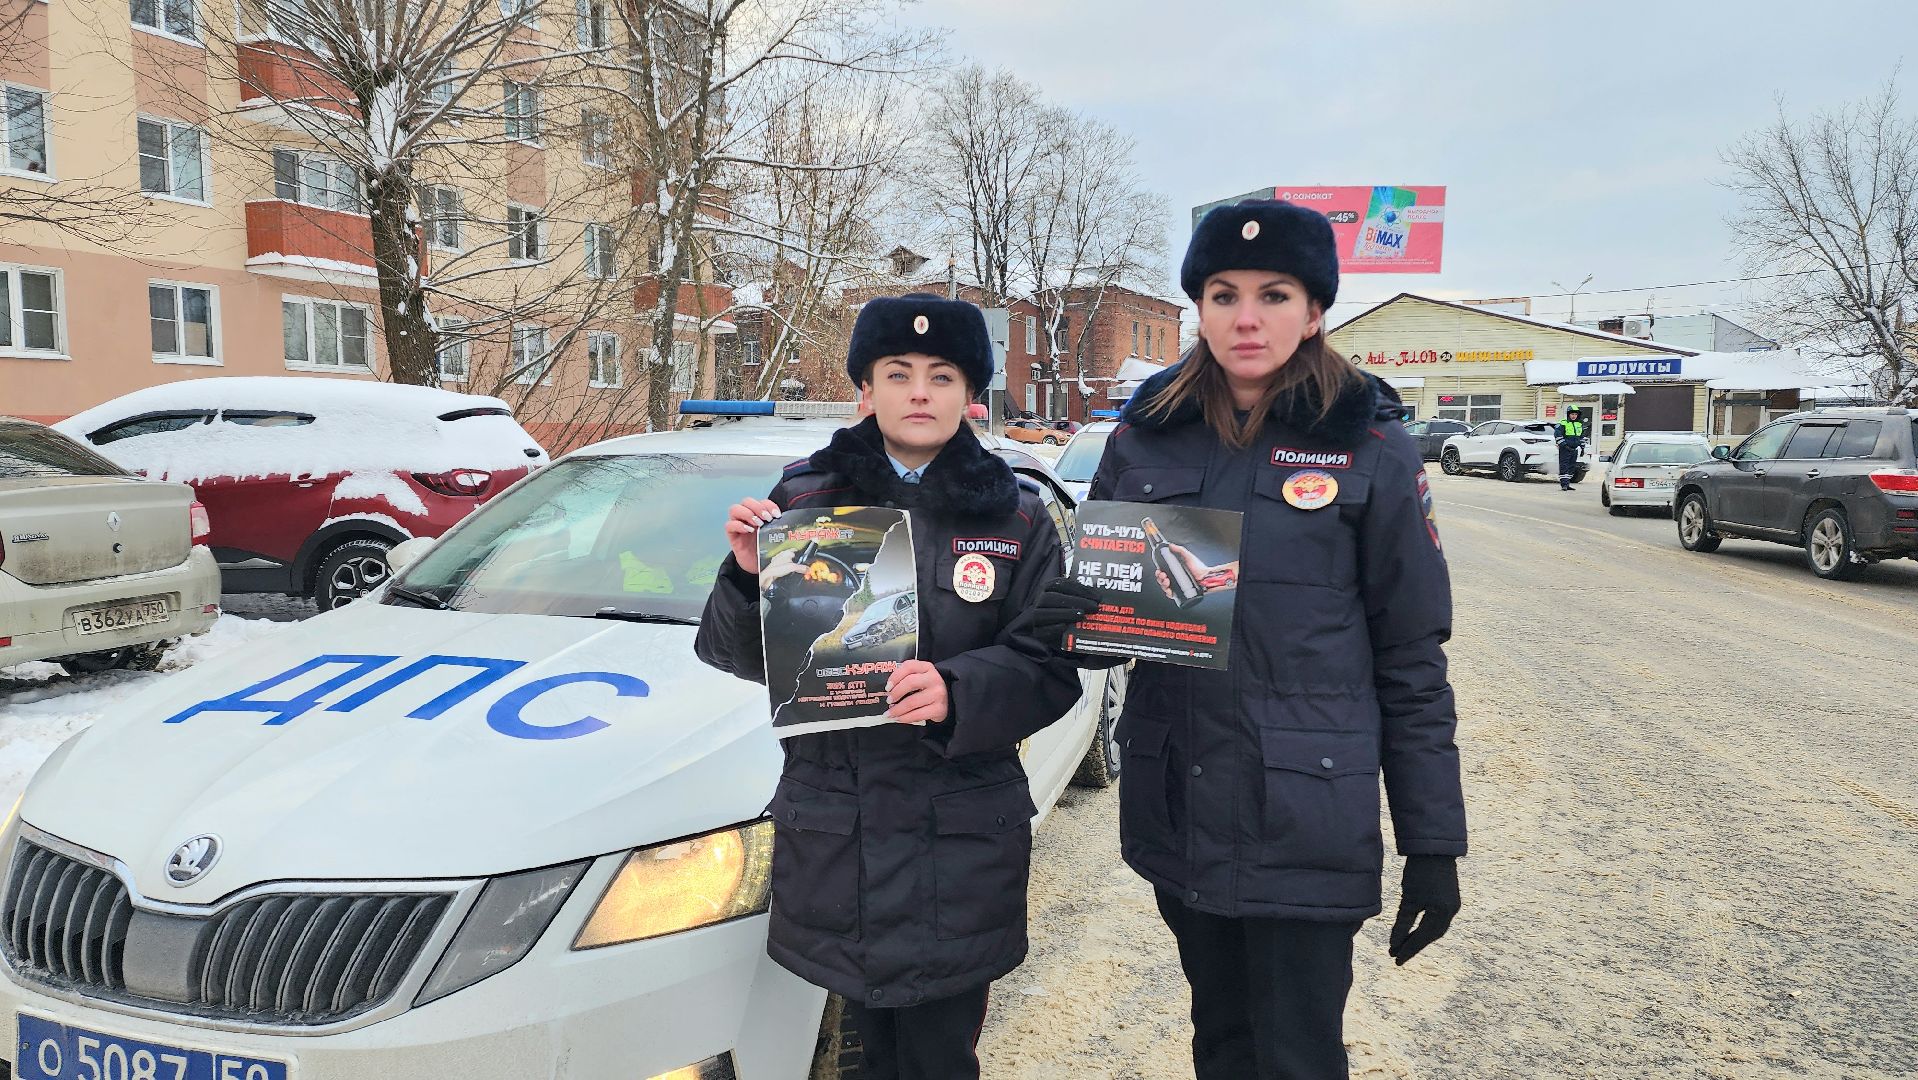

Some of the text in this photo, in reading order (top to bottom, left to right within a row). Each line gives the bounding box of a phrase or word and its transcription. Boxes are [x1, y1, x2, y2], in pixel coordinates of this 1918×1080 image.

[1330, 212, 1355, 222] -45%
[1588, 363, 1671, 375] ПРОДУКТЫ
[1274, 449, 1348, 466] ПОЛИЦИЯ
[1082, 523, 1146, 540] ЧУТЬ-ЧУТЬ
[957, 541, 1018, 555] ПОЛИЦИЯ
[1080, 536, 1146, 554] СЧИТАЕТСЯ
[1078, 560, 1143, 580] НЕ ПЕЙ
[1077, 575, 1143, 593] ЗА РУЛЁМ
[80, 602, 165, 631] В362УА 750
[162, 654, 651, 740] ДПС
